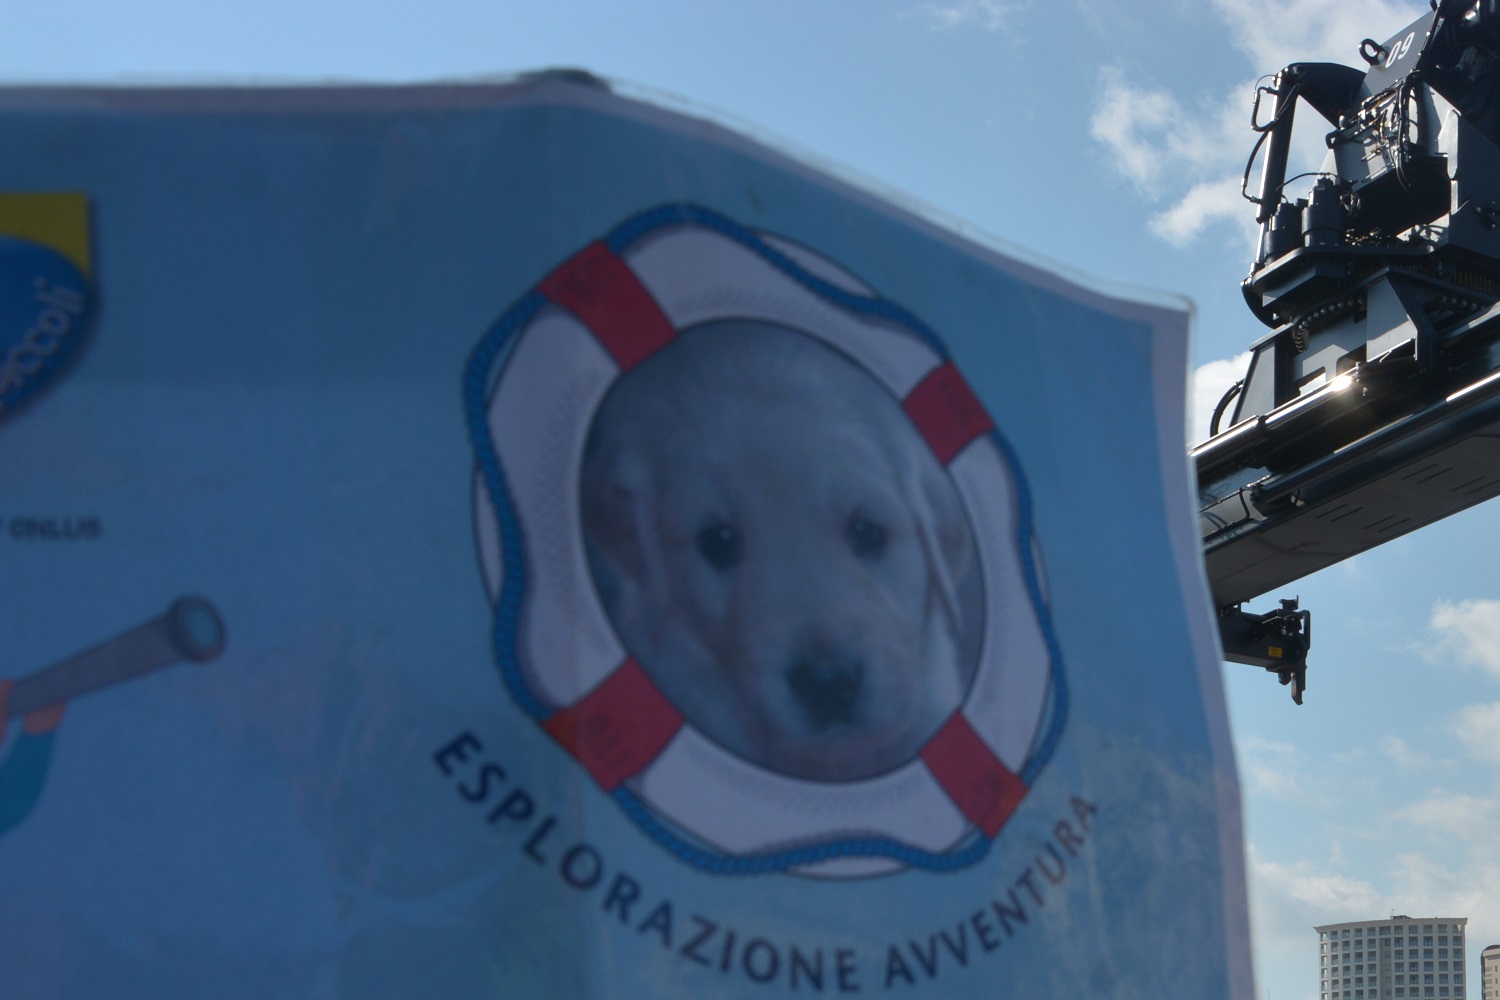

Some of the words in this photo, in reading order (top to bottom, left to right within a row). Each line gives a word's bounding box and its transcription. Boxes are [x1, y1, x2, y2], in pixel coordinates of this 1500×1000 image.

[1385, 32, 1415, 68] 09
[431, 730, 861, 995] ESPLORAZIONE
[884, 795, 1098, 989] AVVENTURA
